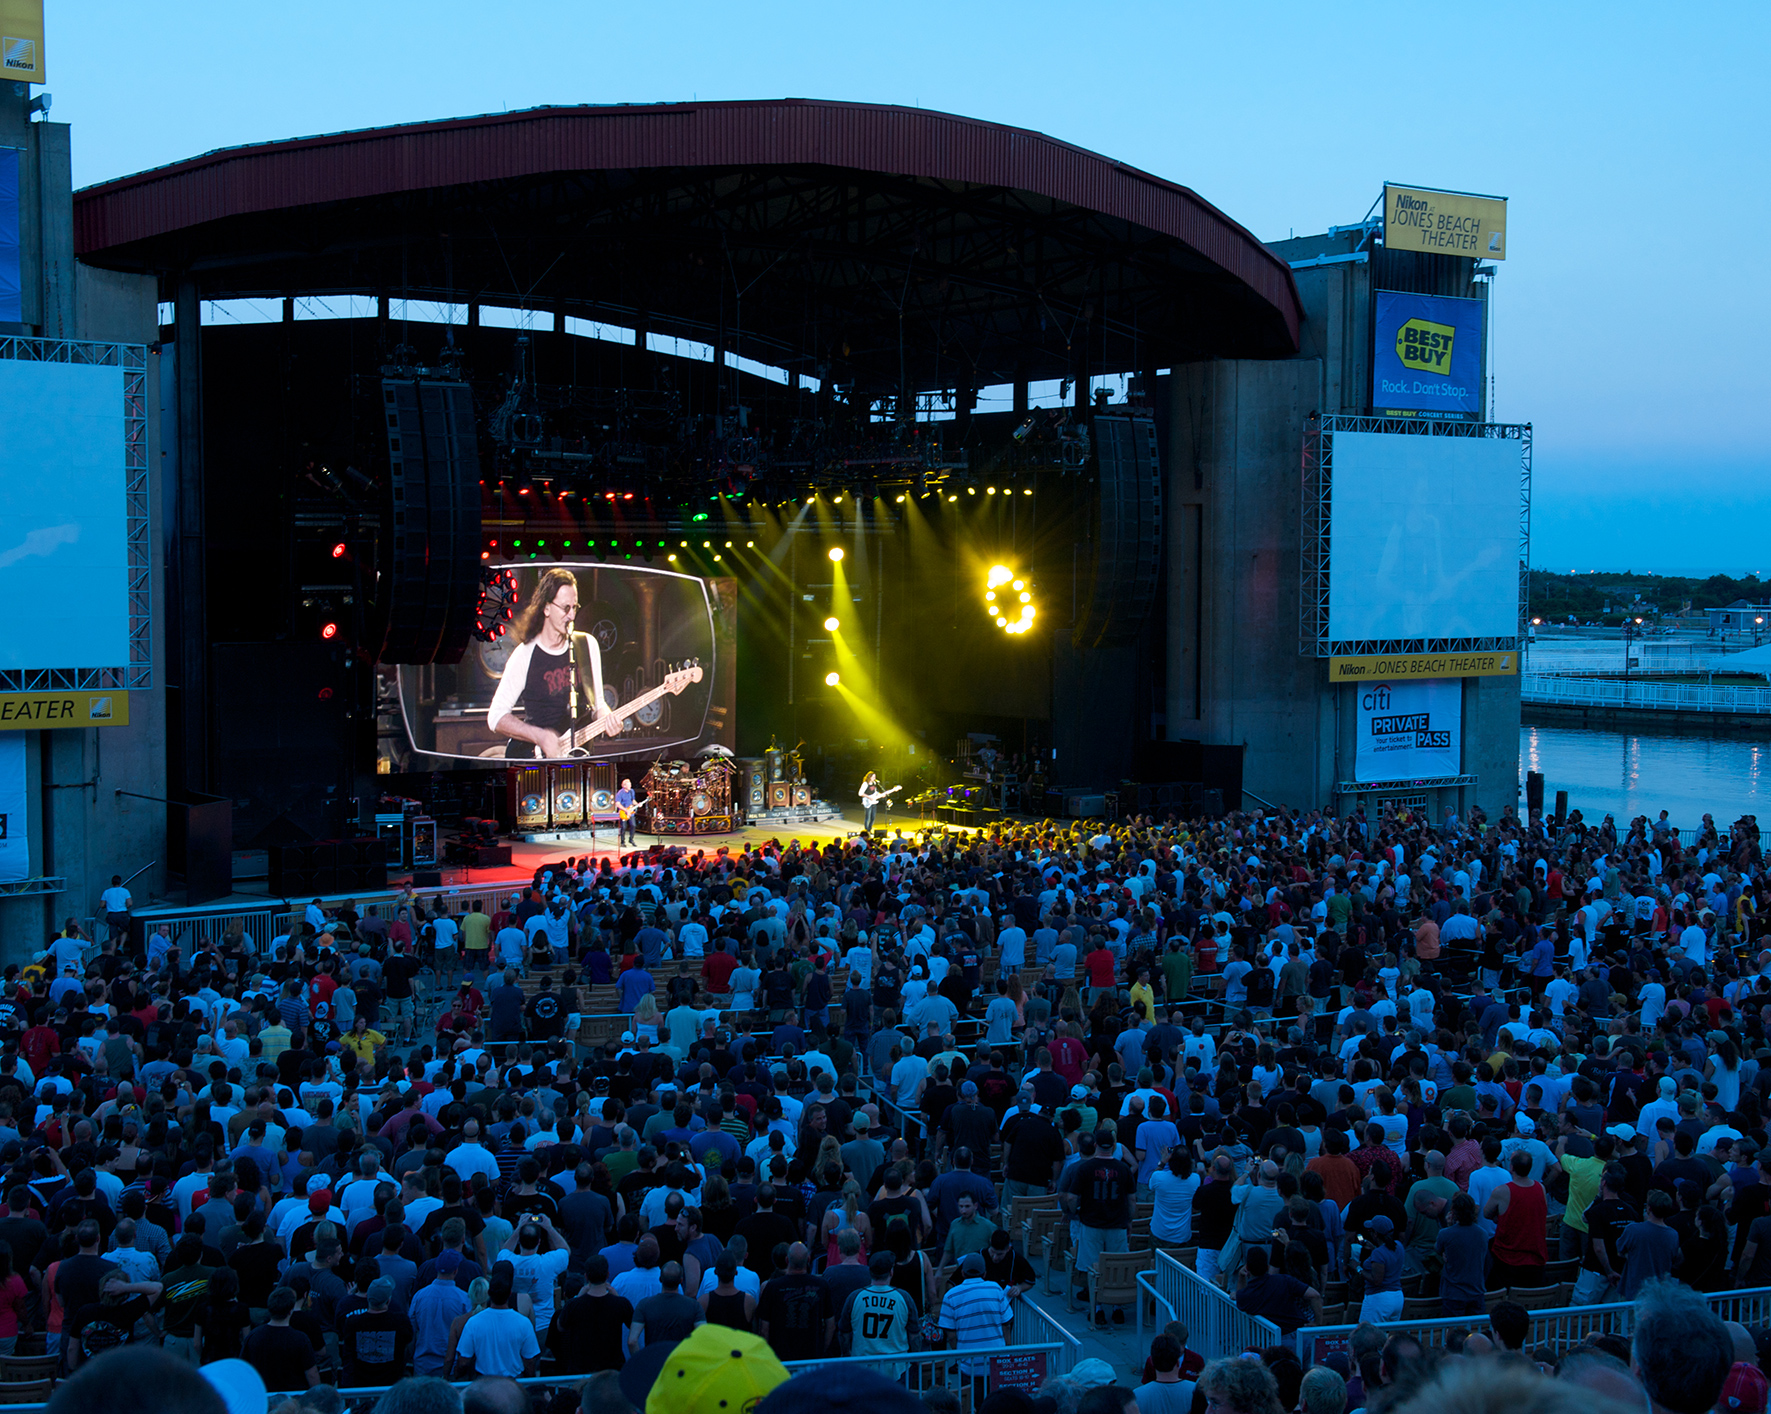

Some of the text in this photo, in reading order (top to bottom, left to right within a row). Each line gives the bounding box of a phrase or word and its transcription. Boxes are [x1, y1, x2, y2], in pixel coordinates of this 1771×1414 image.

[6, 59, 33, 69] Nikon
[1396, 194, 1428, 211] Nikon
[1391, 210, 1480, 233] JONES BEACH
[1422, 229, 1478, 250] THEATER
[1404, 327, 1452, 351] BEST
[1404, 344, 1447, 366] BUY
[1382, 379, 1469, 400] Rock. Don't Stop.
[1339, 664, 1365, 675] Nikon
[1373, 661, 1407, 674] JONES
[1410, 659, 1446, 673] BEACH
[1449, 658, 1495, 671] THEATER
[1362, 688, 1391, 711] citi
[1373, 715, 1427, 734] PRIVATE
[1388, 735, 1406, 743] ticket
[1417, 732, 1449, 746] PASS
[863, 1296, 896, 1311] TOUR
[862, 1312, 894, 1339] 07
